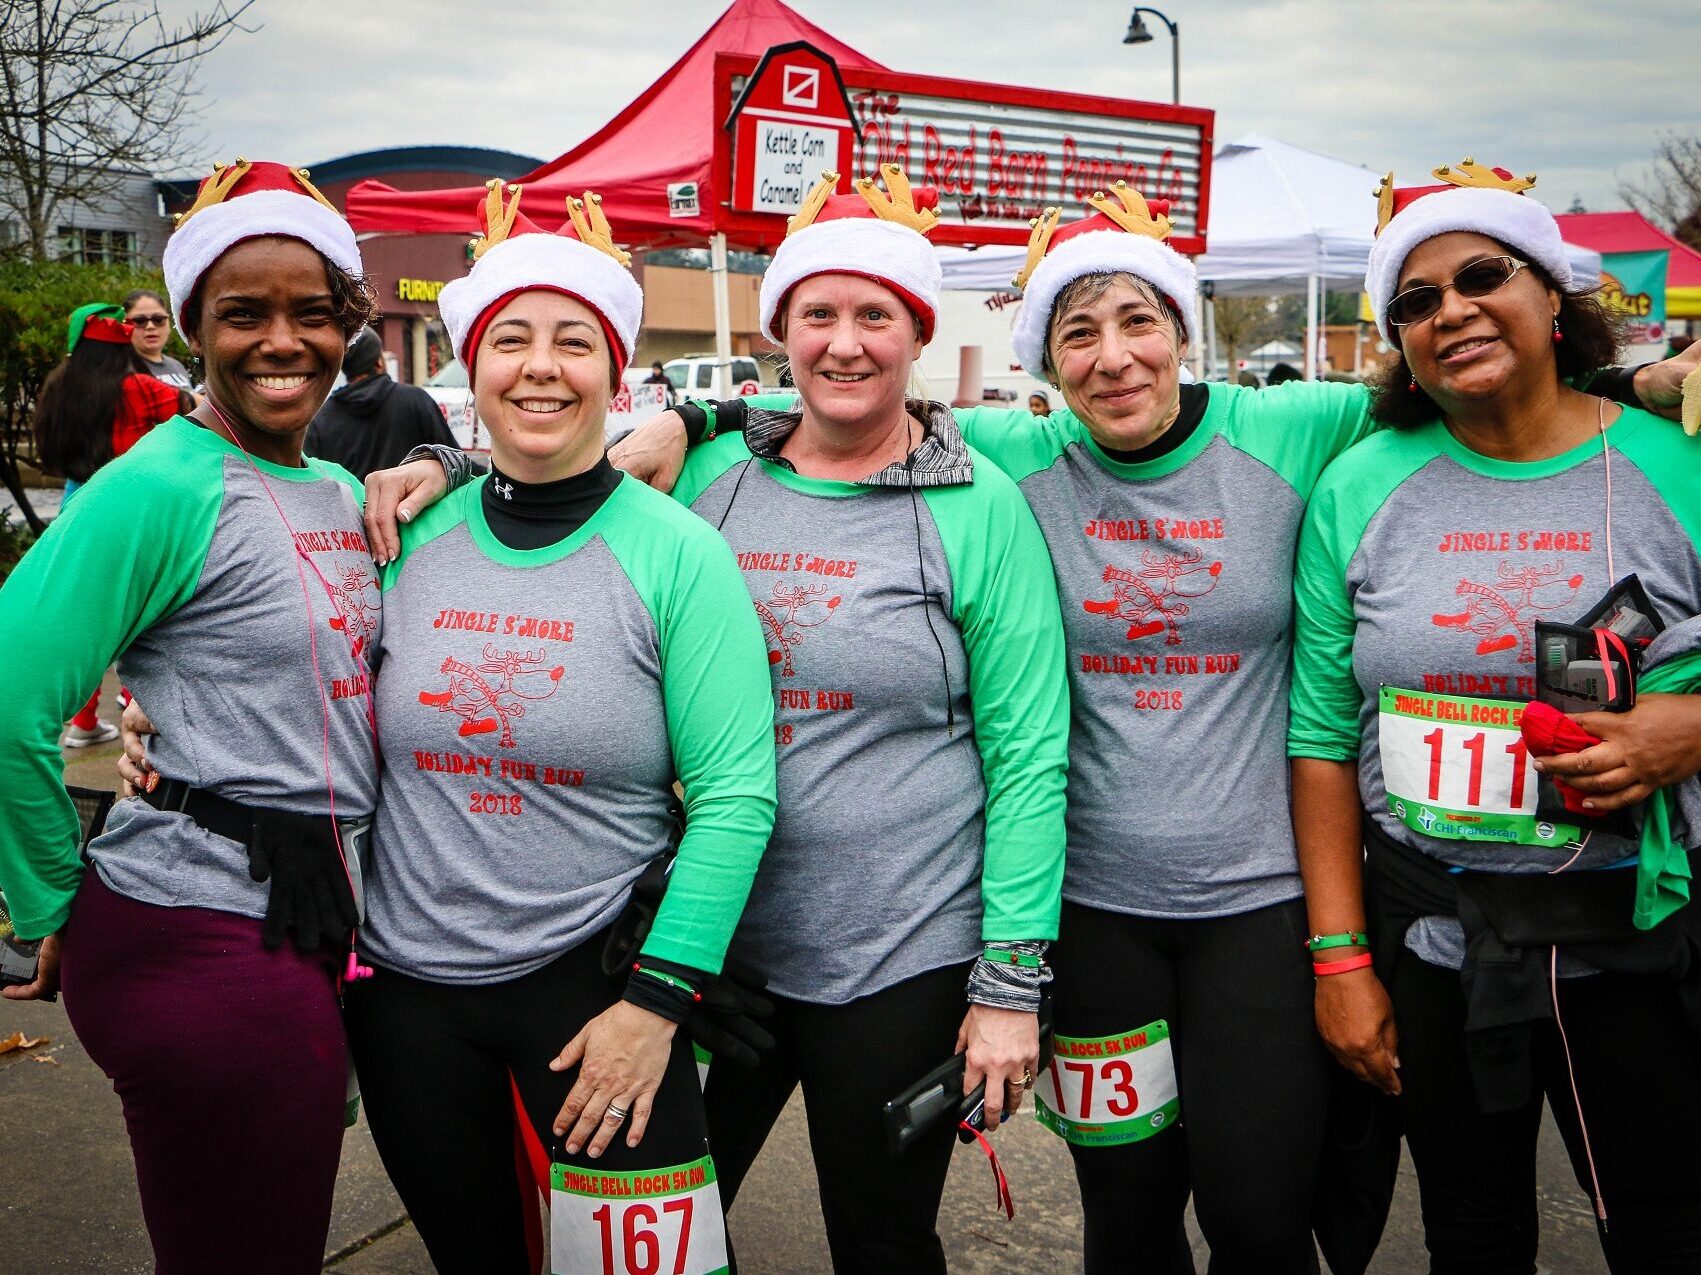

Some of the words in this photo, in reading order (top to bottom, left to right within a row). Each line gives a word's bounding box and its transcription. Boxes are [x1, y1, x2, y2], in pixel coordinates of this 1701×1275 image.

[852, 89, 901, 121] The
[765, 128, 797, 155] Kettle
[802, 131, 825, 157] Corn
[784, 158, 803, 175] and
[860, 118, 911, 184] Old
[922, 122, 977, 197] Red
[987, 127, 1048, 203] Barn
[760, 178, 803, 205] Caramel
[399, 278, 445, 301] FURNIT
[331, 529, 368, 553] S'MOR
[1084, 518, 1150, 541] JINGLE
[1154, 517, 1225, 540] S'MORE
[1438, 531, 1511, 552] JINGLE
[1517, 530, 1593, 552] S'MORE
[793, 552, 857, 579] S'MORE
[433, 608, 499, 633] JINGLE
[503, 614, 575, 643] S'MORE
[1081, 654, 1159, 675] HOLIDAY
[1165, 655, 1199, 675] FUN
[1205, 654, 1240, 675] RUN
[1423, 671, 1508, 695] HOLIDAY
[1515, 674, 1537, 697] FU
[780, 689, 810, 710] FUN
[816, 690, 855, 711] RUN
[1134, 689, 1184, 711] 2018
[1394, 694, 1434, 718] JINGLE
[1436, 700, 1467, 721] BELL
[1470, 704, 1509, 725] ROCK
[774, 724, 793, 745] 18
[414, 751, 493, 777] HOLIDAY
[500, 758, 536, 781] FUN
[543, 766, 586, 787] RUN
[1423, 727, 1528, 809] 111
[469, 792, 523, 816] 2018
[1434, 822, 1454, 835] CHI
[1457, 825, 1517, 839] Franciscan
[1070, 1042, 1103, 1057] ROCK
[1104, 1039, 1122, 1054] 5K
[1122, 1032, 1147, 1051] RUN
[564, 1171, 599, 1194] JINGLE
[601, 1176, 631, 1196] BELL
[634, 1174, 670, 1195] ROCK
[672, 1172, 689, 1190] 5K
[689, 1165, 705, 1186] RUN
[592, 1196, 694, 1275] 167
